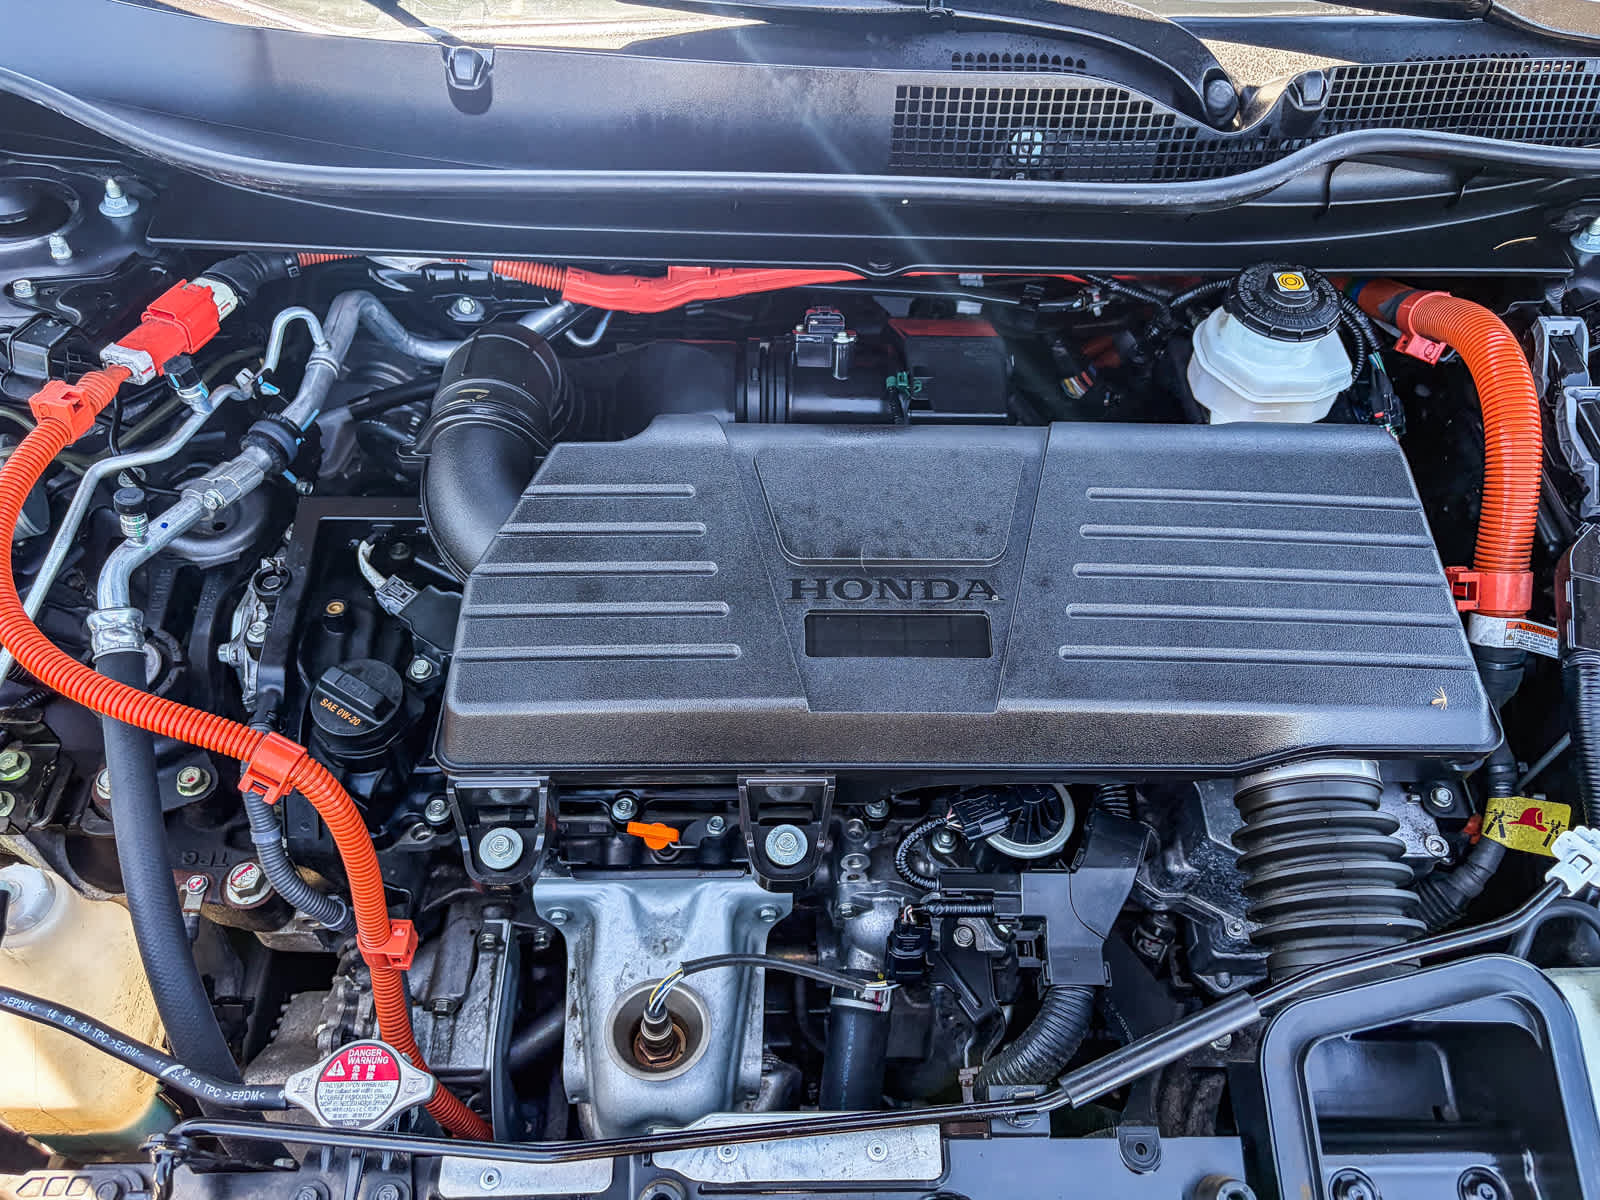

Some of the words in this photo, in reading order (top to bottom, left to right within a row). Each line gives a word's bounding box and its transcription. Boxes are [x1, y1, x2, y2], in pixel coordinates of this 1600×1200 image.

[786, 577, 1004, 602] HONDA
[320, 698, 339, 712] SAE
[336, 708, 361, 726] 0W-20
[63, 1014, 76, 1026] 02
[92, 1028, 110, 1043] TPC
[203, 1083, 222, 1098] TPC
[224, 1090, 266, 1101] >EPDM<
[347, 1056, 388, 1064] WARNUNG
[349, 1048, 382, 1057] DANGER
